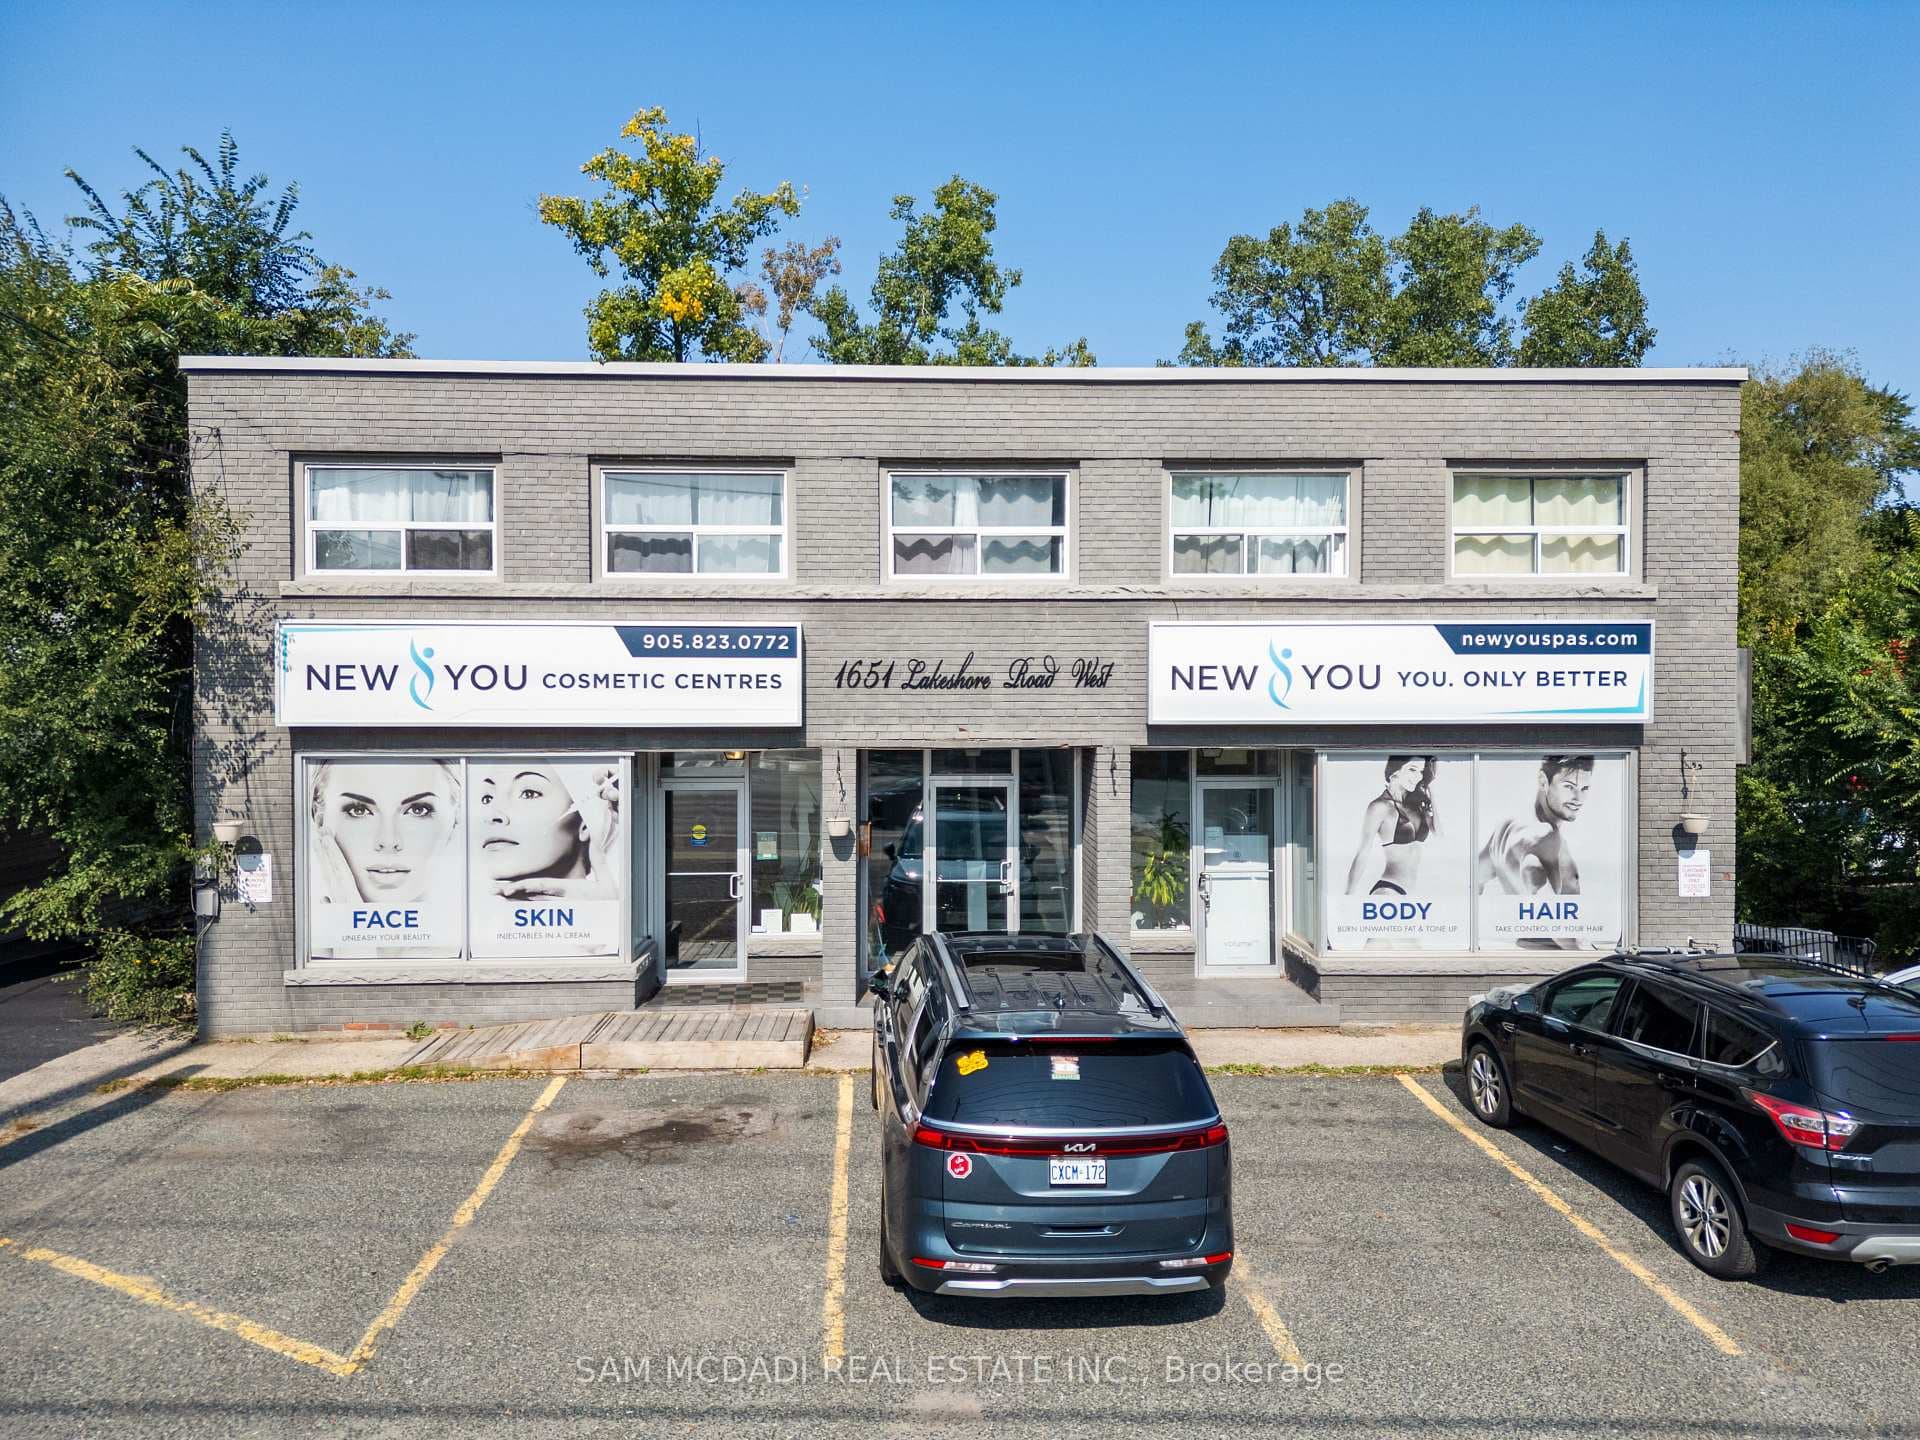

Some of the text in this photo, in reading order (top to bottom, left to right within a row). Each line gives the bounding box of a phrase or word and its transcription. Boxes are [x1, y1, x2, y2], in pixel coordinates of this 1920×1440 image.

[642, 632, 790, 651] 905.823.0772
[1461, 633, 1638, 653] newyouspas.com
[305, 663, 783, 692] NEW YOU COSMETIC CENTRES
[834, 651, 1115, 690] 1651 Lakeshore Road West
[1170, 663, 1628, 691] NEW YOU YOU. ONLY BETTER
[352, 909, 420, 929] FACE
[513, 908, 574, 927] SKIN
[1362, 901, 1433, 921] BODY
[1518, 901, 1580, 920] HAIR
[342, 934, 377, 942] UNLEASH
[403, 933, 431, 941] BEAUTY
[497, 932, 543, 940] INJECTABLES
[1360, 925, 1402, 933] UNWANTED
[1405, 925, 1418, 933] FAT
[1427, 925, 1446, 933] TONE
[1449, 925, 1458, 933] UP
[1495, 925, 1512, 933] TAKE
[1514, 925, 1550, 933] CONTROL
